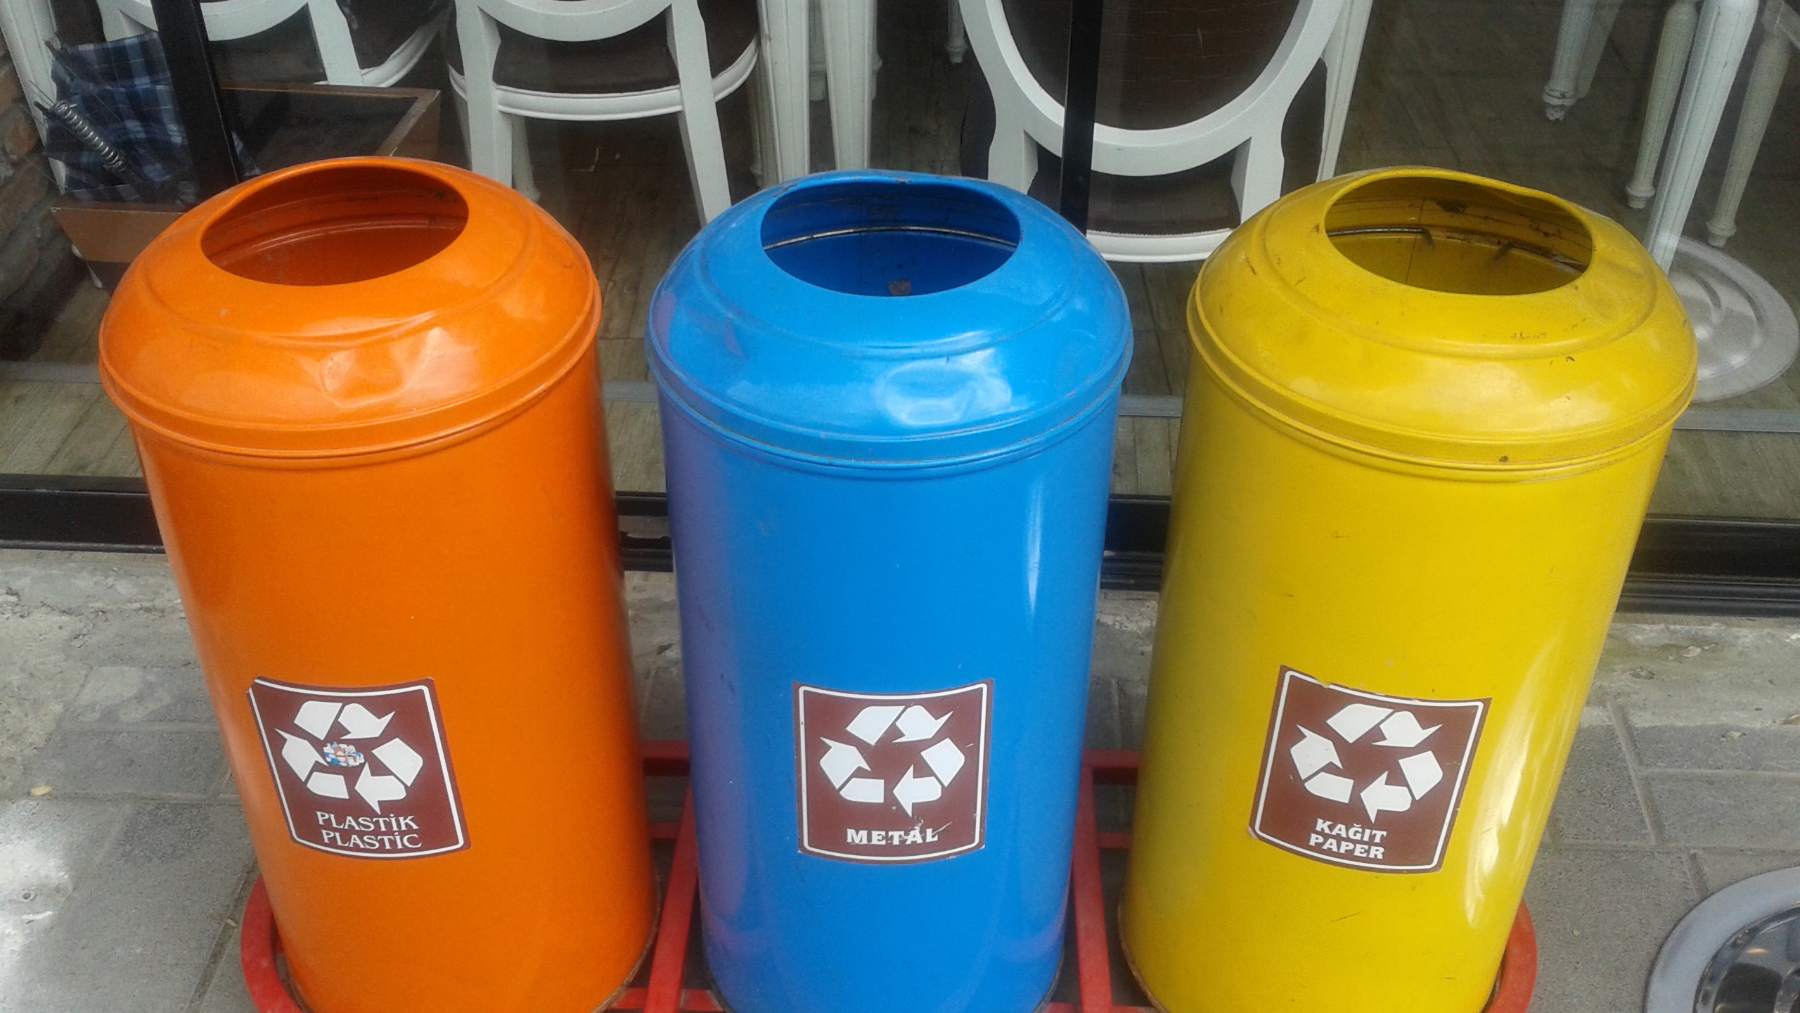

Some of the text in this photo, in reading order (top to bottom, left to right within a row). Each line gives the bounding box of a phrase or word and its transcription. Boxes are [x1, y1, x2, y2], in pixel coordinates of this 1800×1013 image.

[316, 811, 420, 832] PLASTİK
[1315, 818, 1387, 843] KAĞIT
[846, 827, 939, 845] METAL
[1308, 833, 1385, 859] PAPER
